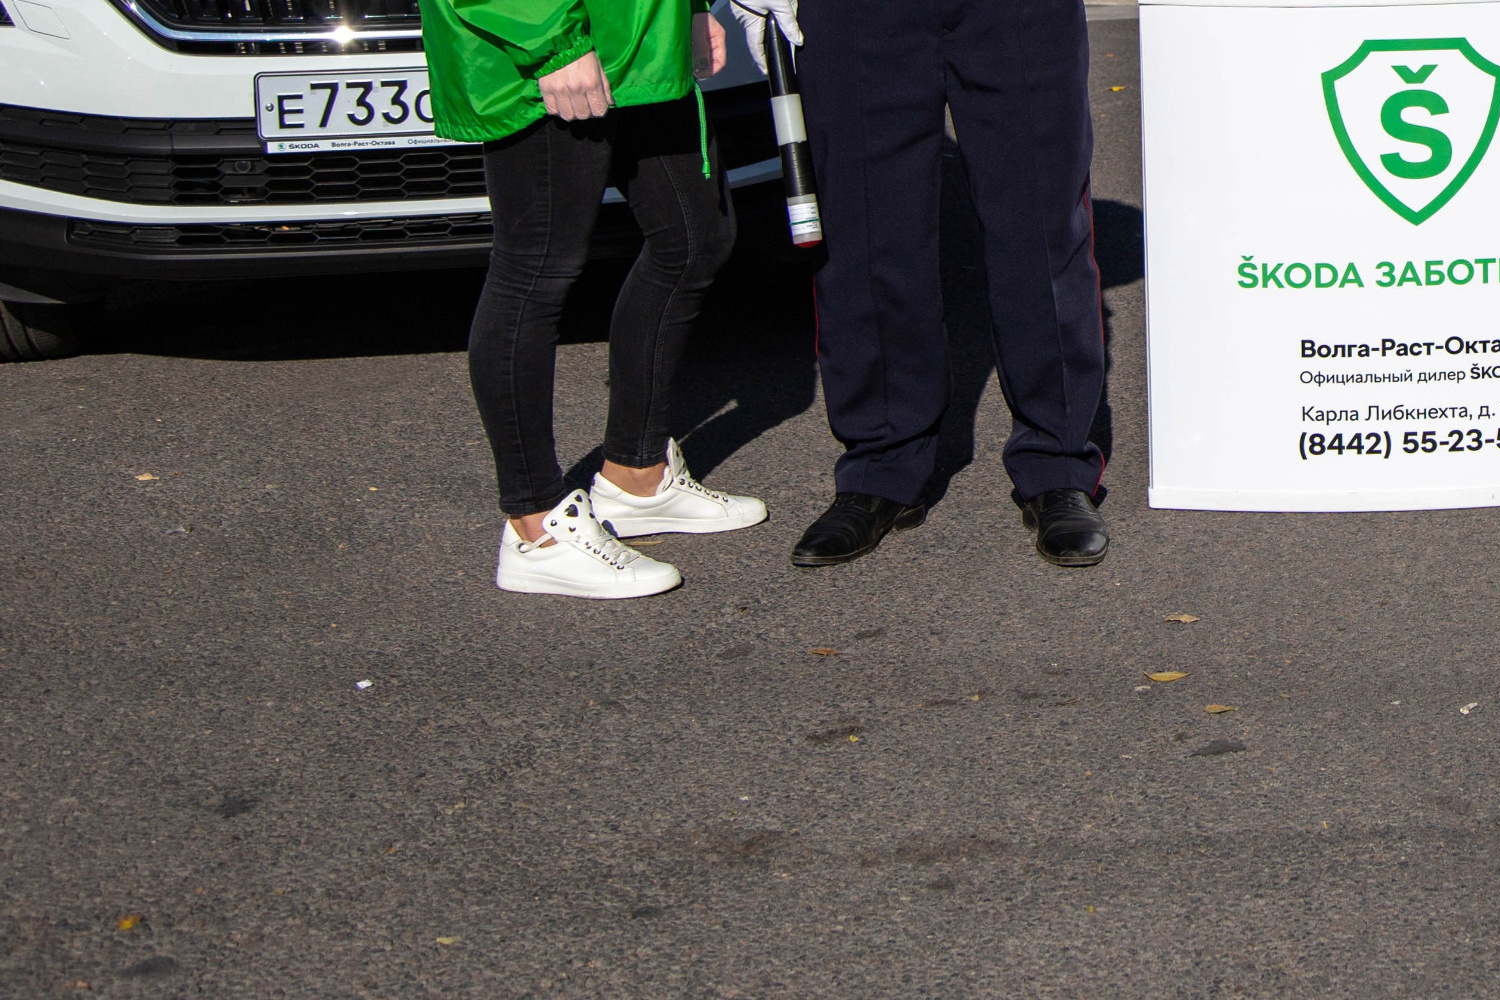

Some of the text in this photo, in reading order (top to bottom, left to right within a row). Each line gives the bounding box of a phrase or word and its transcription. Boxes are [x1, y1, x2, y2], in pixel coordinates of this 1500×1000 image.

[1379, 64, 1453, 180] Š
[331, 140, 396, 148] Волга-Раст-Октава
[1237, 255, 1365, 289] ŠKODA
[1300, 370, 1413, 387] Официальный
[1417, 370, 1466, 383] дилер
[1301, 406, 1359, 425] Карла
[1365, 404, 1473, 421] Либкнехта,
[1477, 405, 1496, 420] д.
[1299, 431, 1391, 460] (8442)
